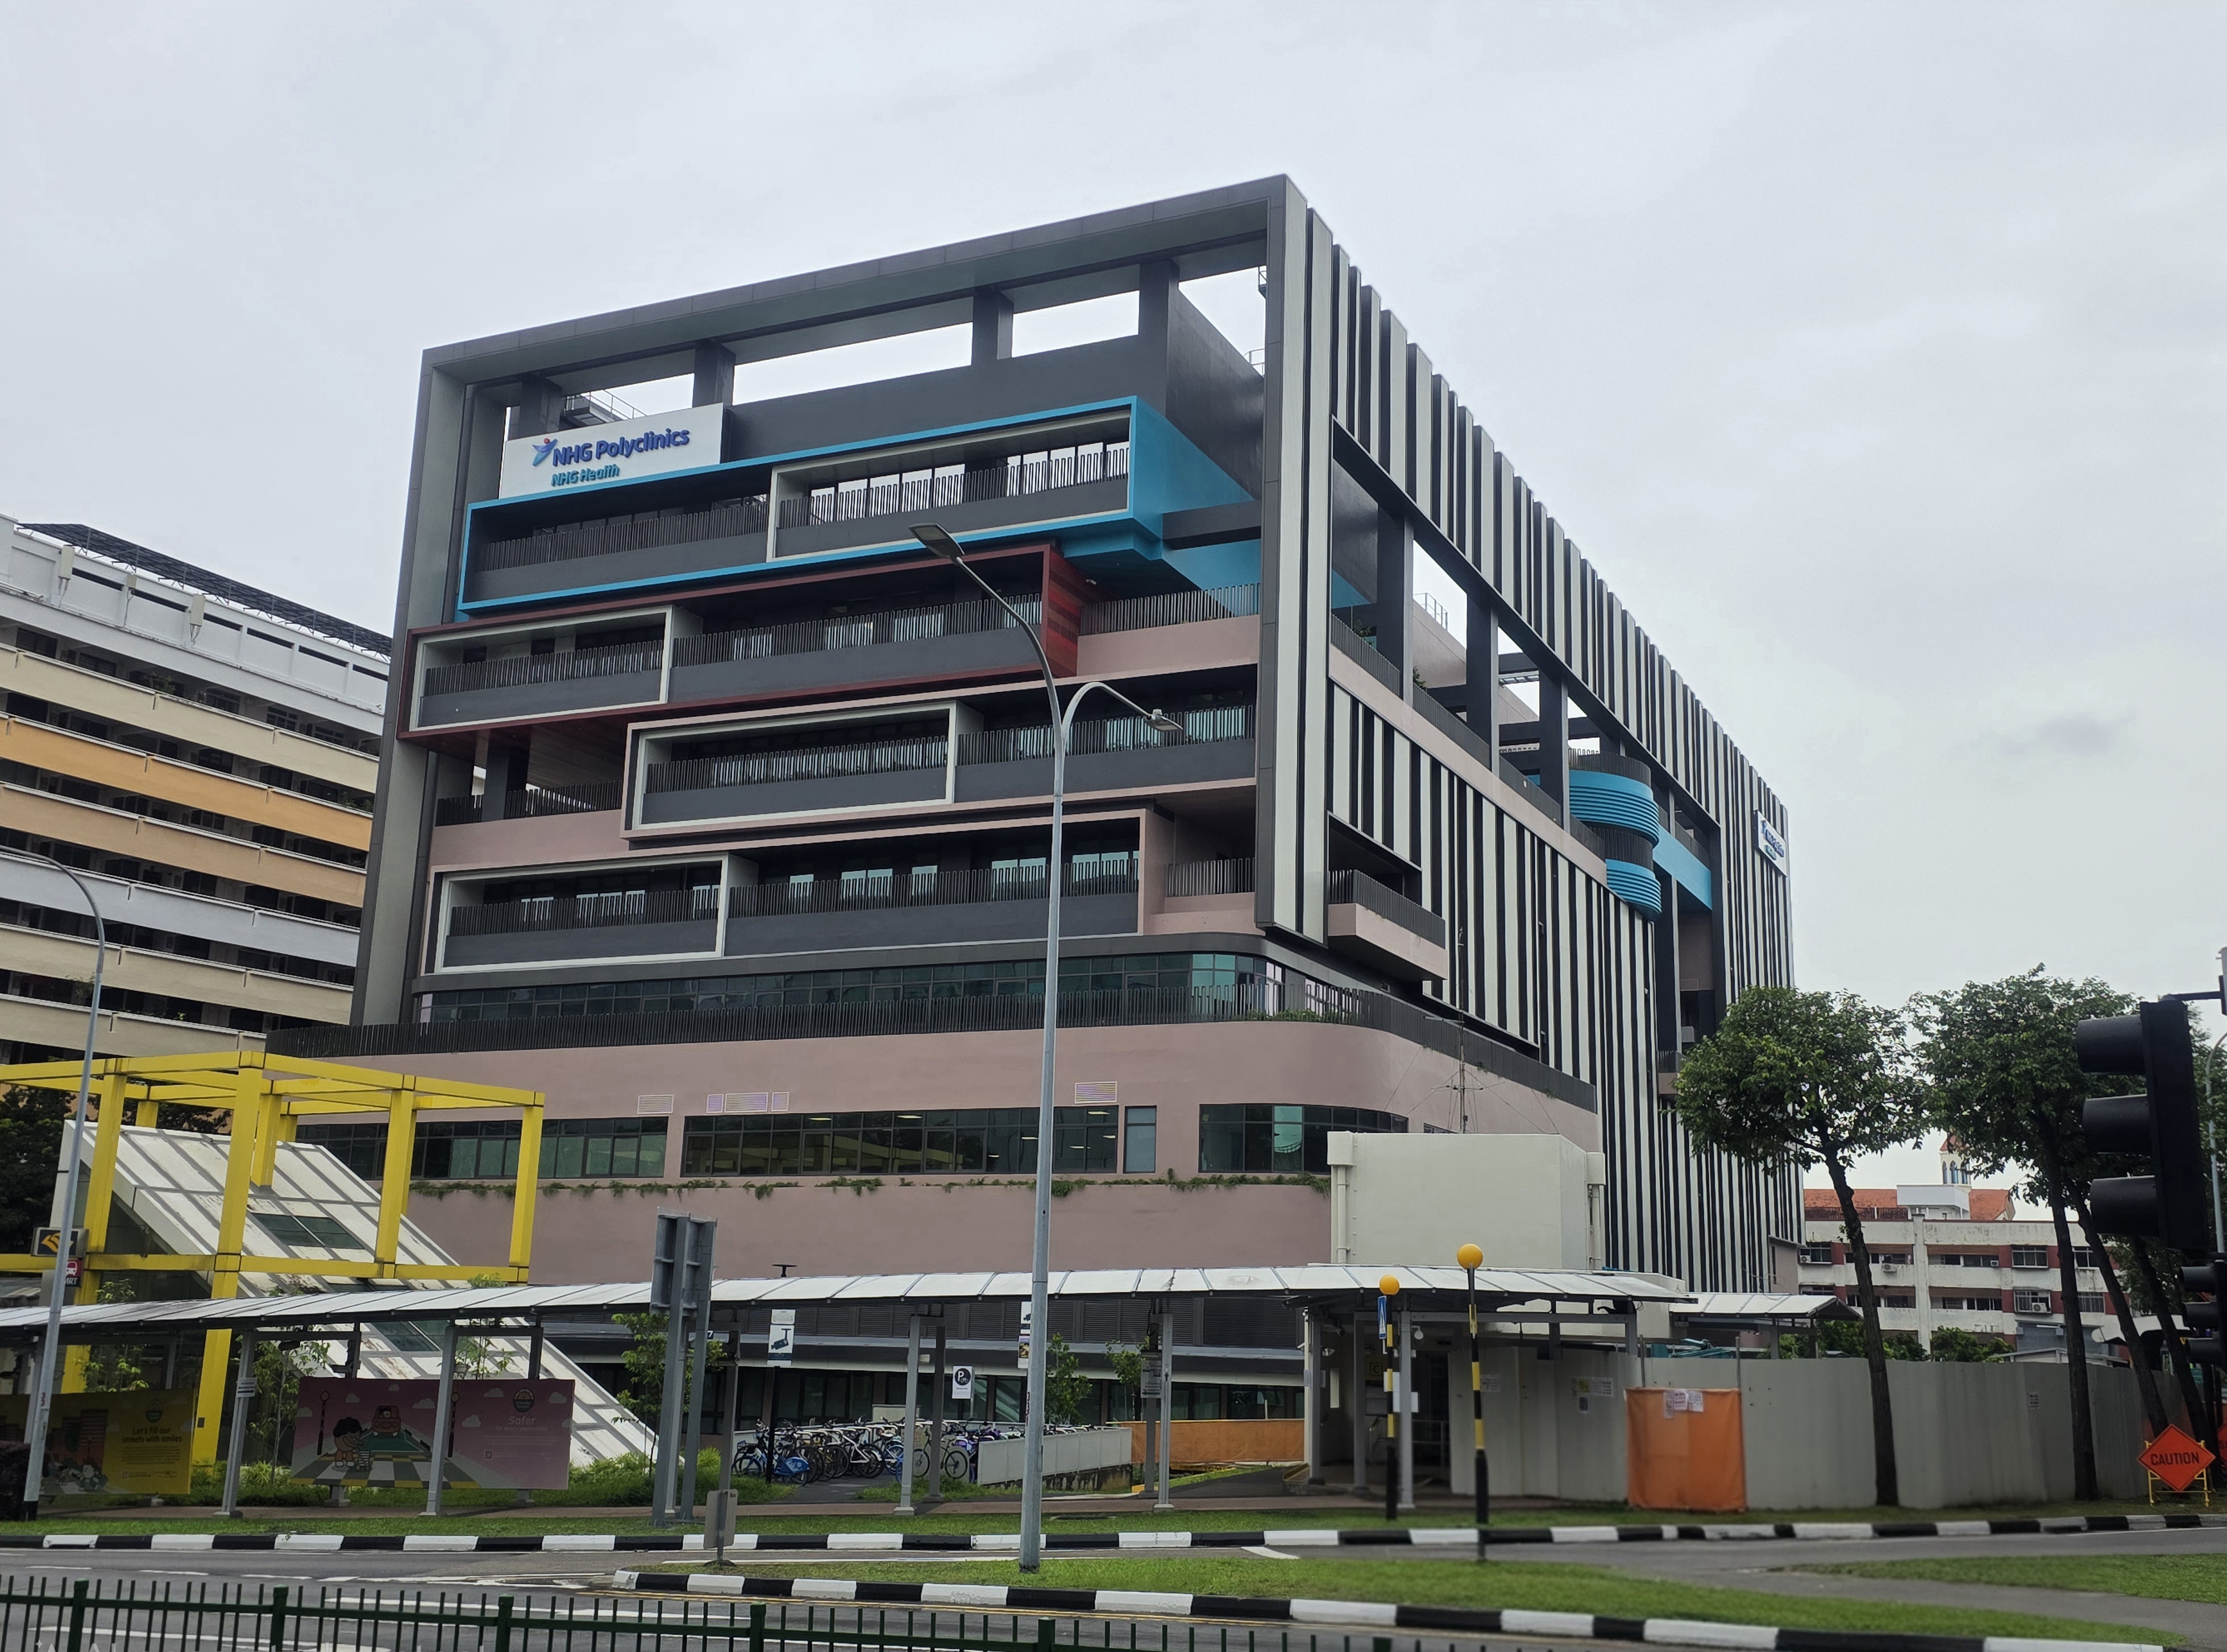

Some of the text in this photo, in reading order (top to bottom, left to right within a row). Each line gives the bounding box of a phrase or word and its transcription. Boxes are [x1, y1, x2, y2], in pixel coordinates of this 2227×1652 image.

[552, 427, 690, 467] NHG Polyclinics
[551, 463, 620, 487] NHG Health
[957, 1371, 965, 1382] P
[508, 1416, 536, 1425] Safer
[2150, 1451, 2200, 1466] CAUTION
